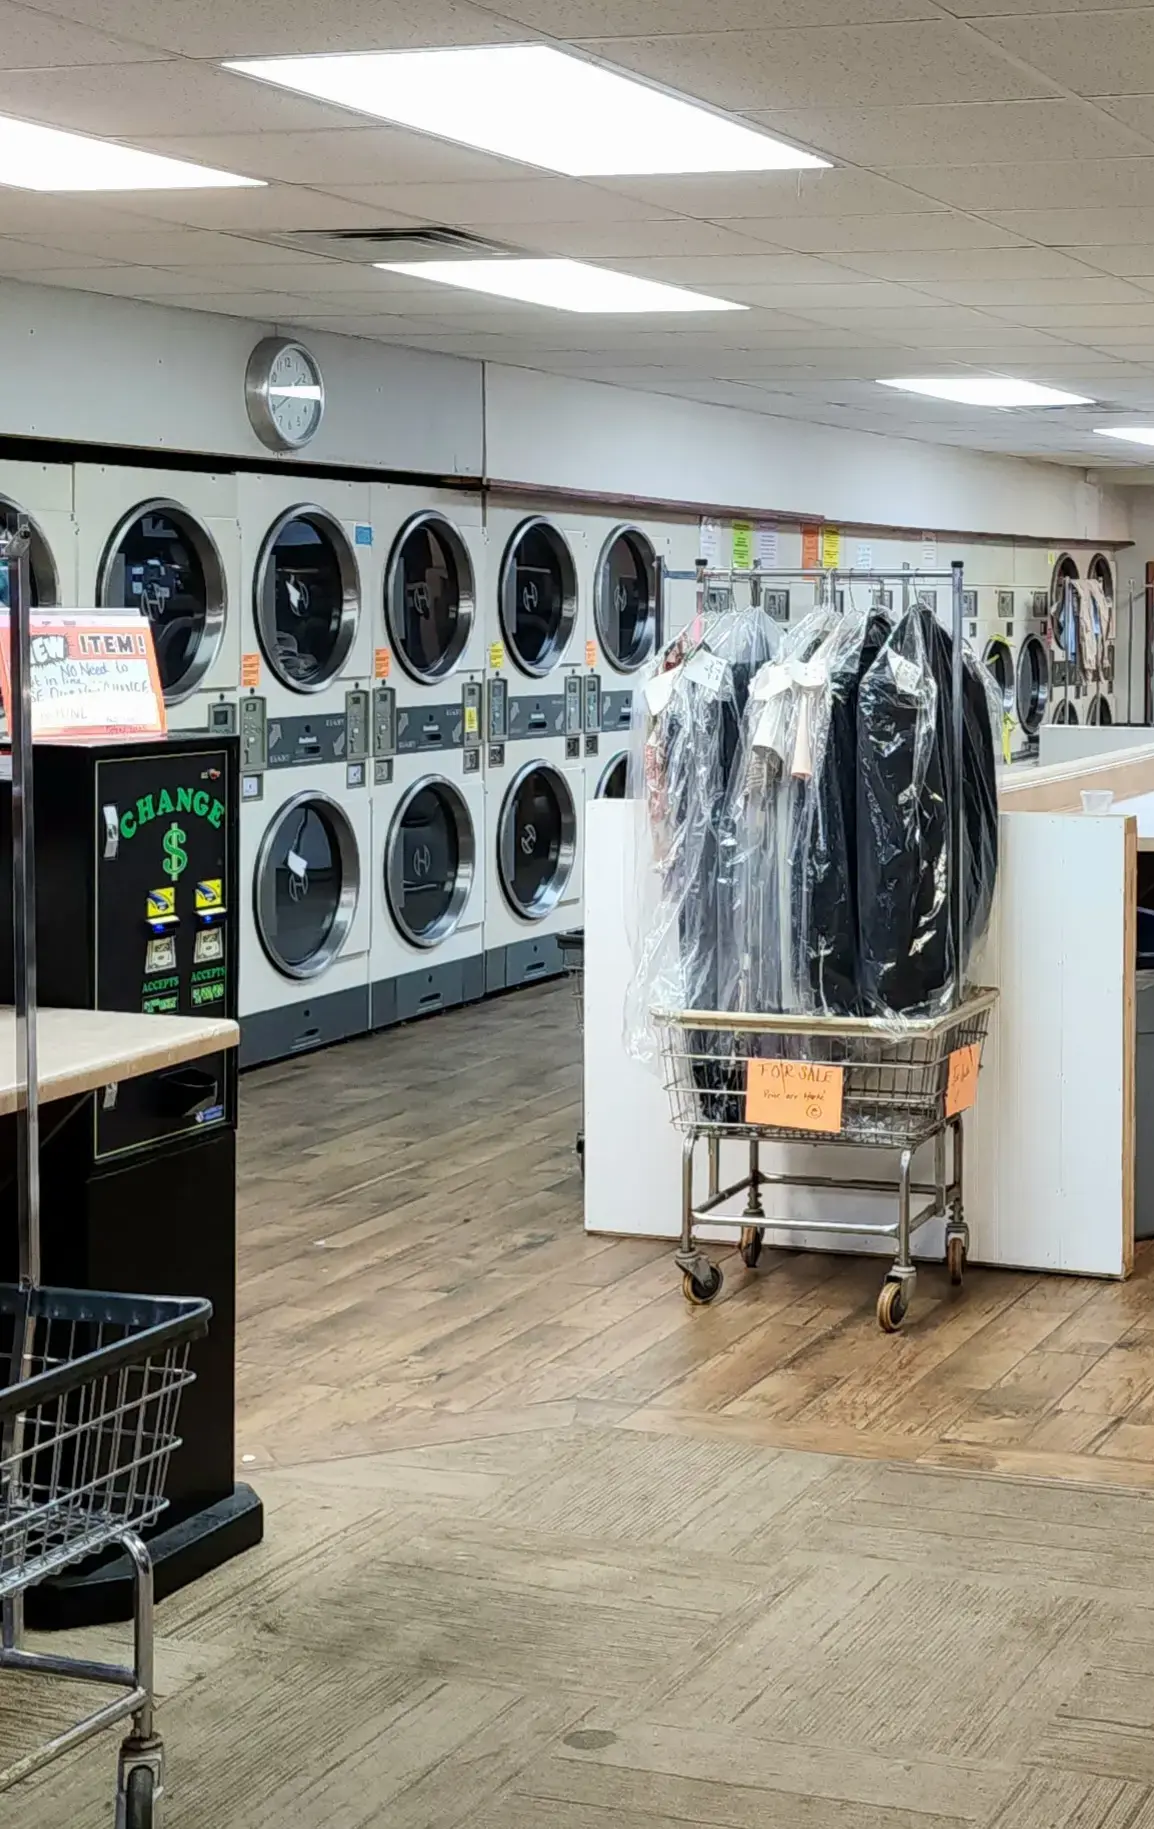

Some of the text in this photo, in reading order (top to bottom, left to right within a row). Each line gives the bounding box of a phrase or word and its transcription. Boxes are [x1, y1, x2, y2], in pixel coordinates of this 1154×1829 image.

[120, 787, 225, 839] CHANGE
[190, 965, 226, 983] ACCEPTS
[142, 975, 180, 994] ACCEPTS
[757, 1062, 834, 1084] FOR SALE
